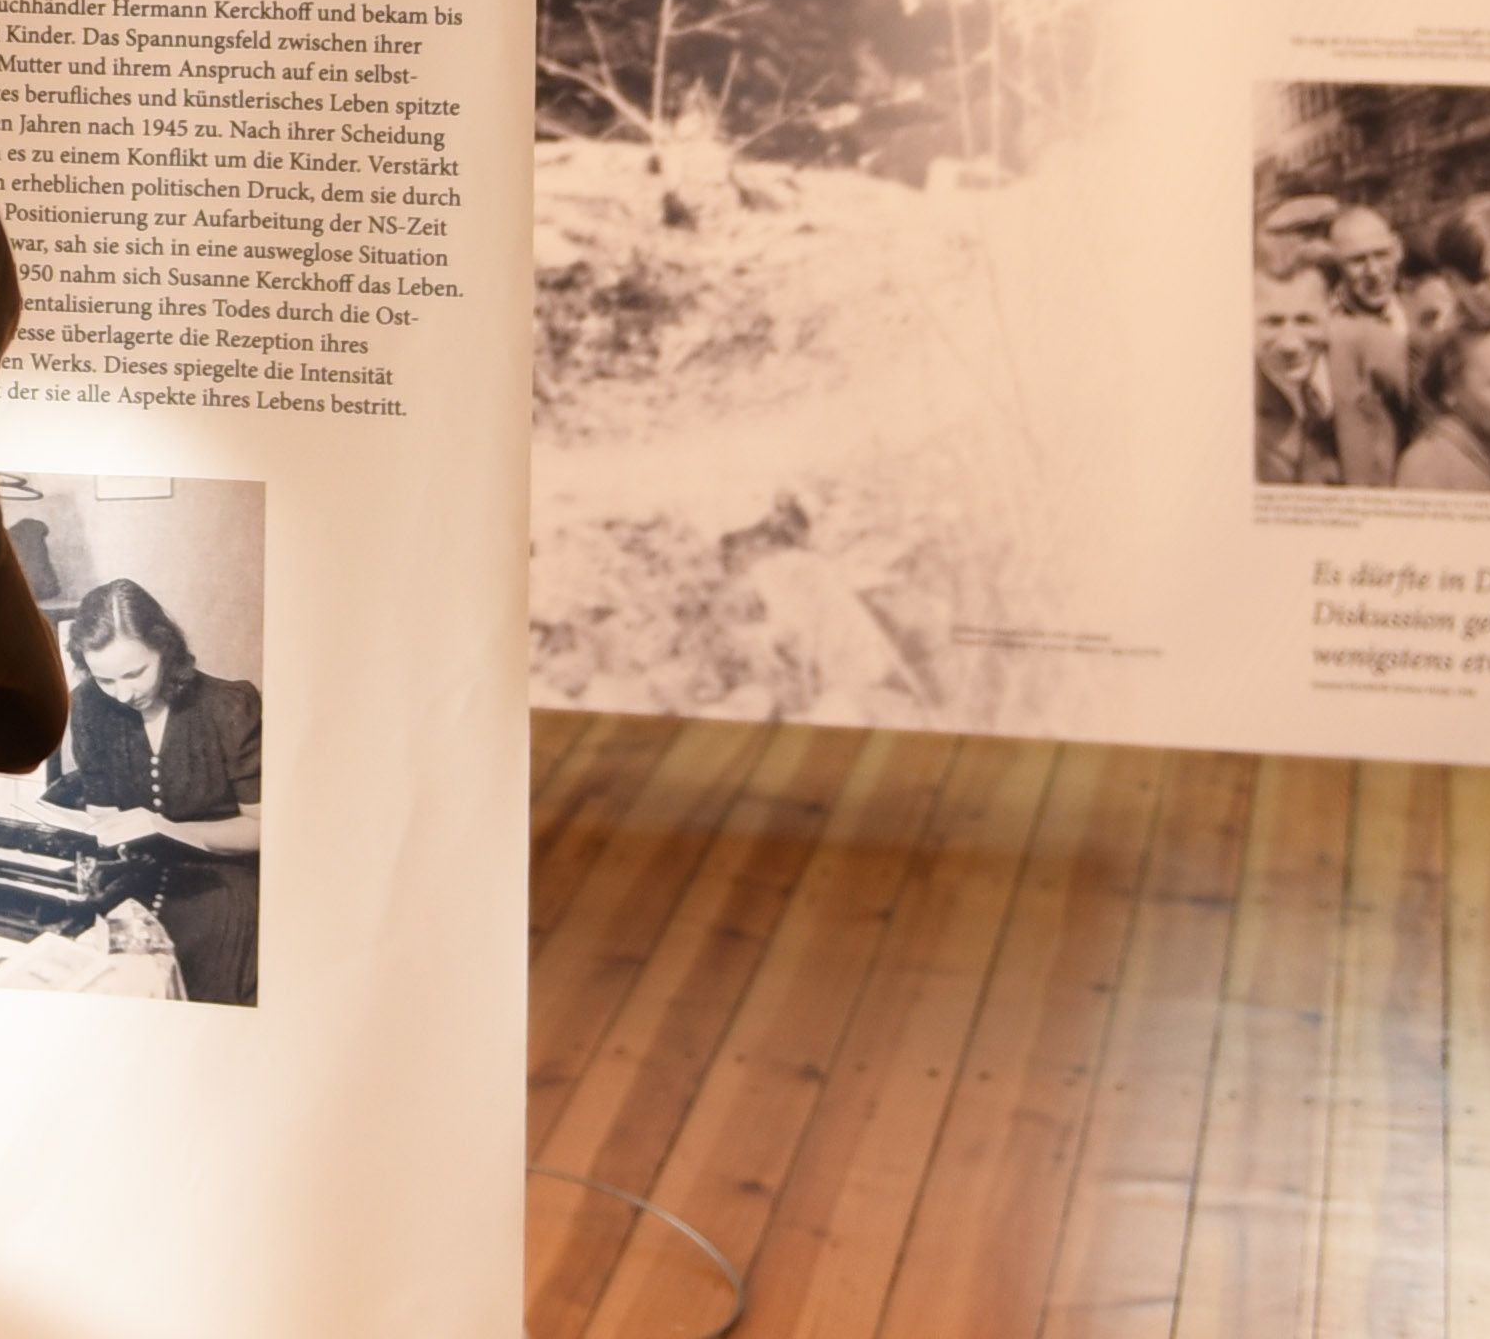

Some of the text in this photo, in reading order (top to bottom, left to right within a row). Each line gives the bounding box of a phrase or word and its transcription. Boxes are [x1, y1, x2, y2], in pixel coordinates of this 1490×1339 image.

[6, 25, 75, 44] Kinder.
[82, 27, 119, 46] Das
[126, 28, 271, 54] Spannungsfeld
[278, 33, 367, 52] zwischen
[374, 34, 422, 54] ihrer
[25, 84, 460, 120] berufliches und künstlerisches Leben spitzte
[6, 203, 447, 237] Positionierung zur Aufarbeitung der NS-Zeit
[60, 265, 463, 297] nahm sich Susanne Kerckhoff das Leben.
[31, 353, 393, 385] Werks. Dieses spiegelte die Intensität
[1313, 560, 1341, 586] Es
[1350, 563, 1431, 596] dürfte
[1439, 570, 1464, 592] in
[1313, 602, 1455, 632] Diskussion
[1313, 644, 1454, 677] wenigstens
